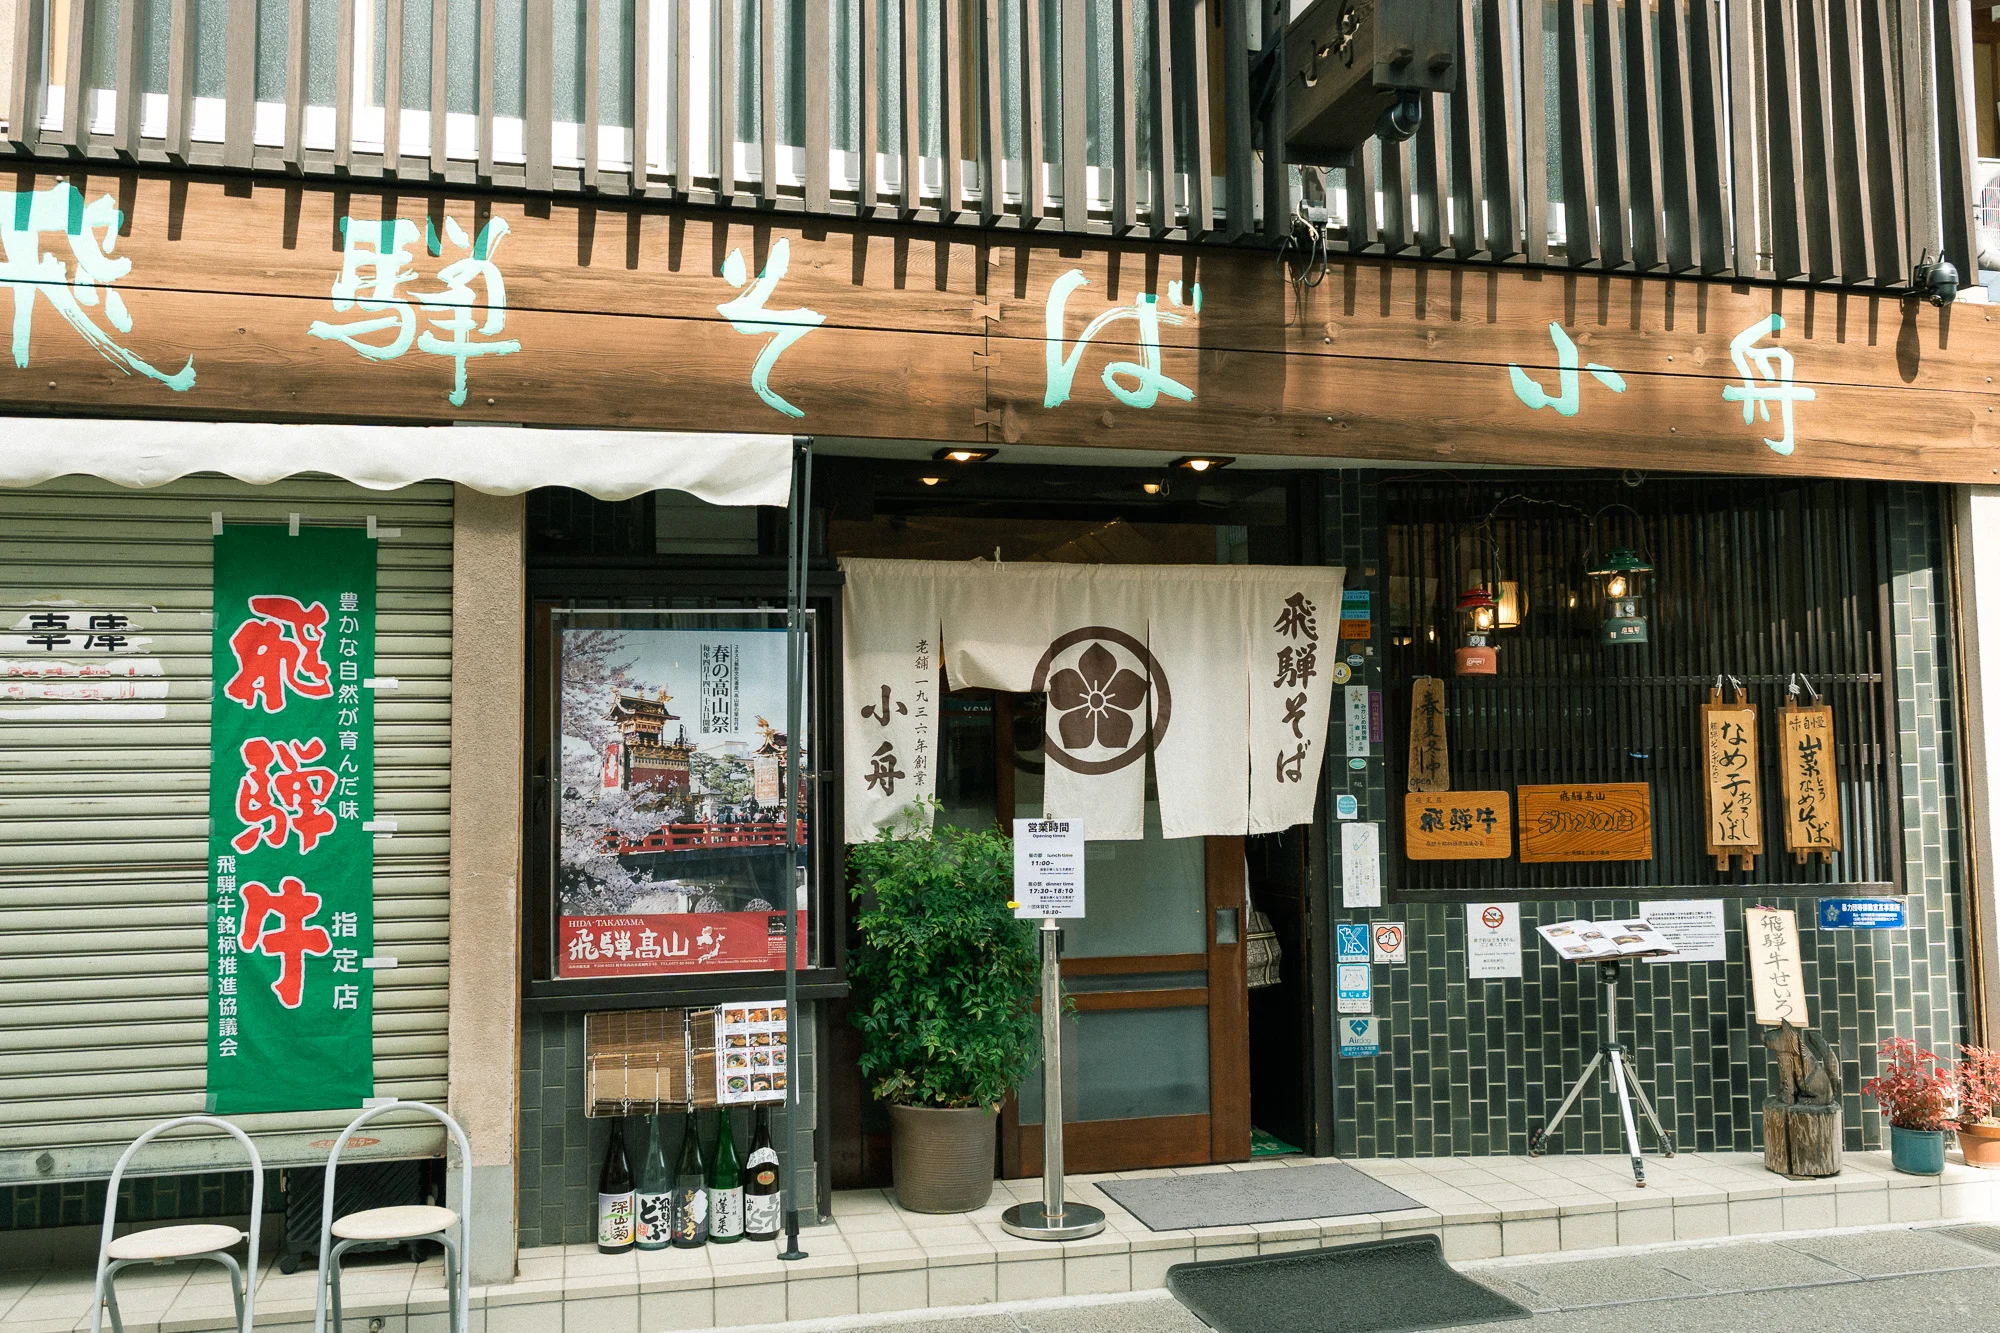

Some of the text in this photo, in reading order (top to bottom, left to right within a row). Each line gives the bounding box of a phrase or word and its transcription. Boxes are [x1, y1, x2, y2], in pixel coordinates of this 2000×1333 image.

[1507, 312, 1816, 456] 小舟
[26, 612, 129, 651] 車庫
[338, 591, 359, 820] 豊かな自然が育んだ味
[711, 644, 730, 734] 春の高山祭
[1273, 591, 1319, 784] 飛騨そば
[860, 684, 909, 797] 小舟
[1027, 822, 1070, 833] 営業時間
[1537, 808, 1634, 834] グルメの店
[216, 855, 238, 1057] 飛騨牛銘柄推進協議会
[332, 912, 359, 1010] 指定店
[568, 918, 645, 928] HIDA-TAKAYAMA
[1760, 915, 1793, 1018] 飛騨牛せいろ
[1348, 1036, 1372, 1044] Airdog
